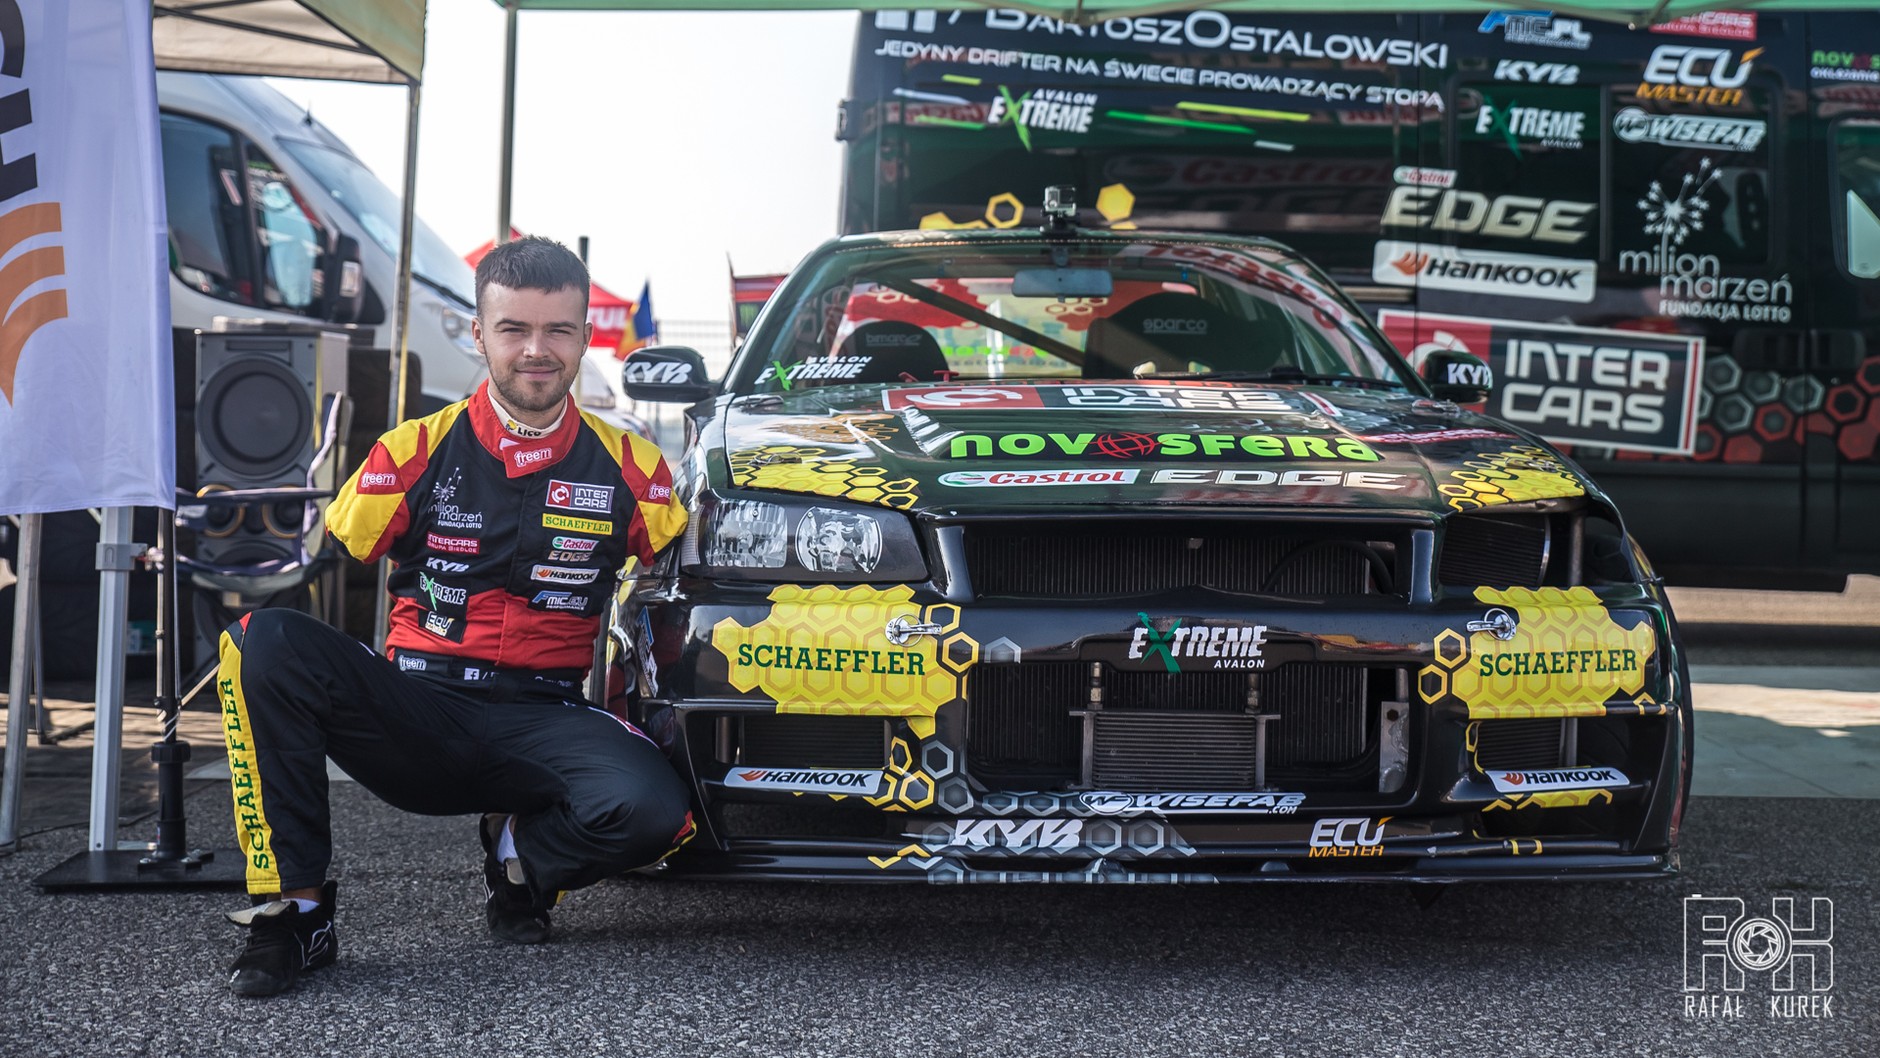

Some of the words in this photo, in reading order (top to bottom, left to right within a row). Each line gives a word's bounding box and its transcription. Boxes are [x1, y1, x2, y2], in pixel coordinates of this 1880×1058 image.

[874, 39, 964, 63] JEDYNY
[967, 46, 1061, 73] DRIFTER
[1065, 57, 1099, 77] NA
[1104, 57, 1195, 85] ŚWIECIE
[1199, 69, 1362, 101] PROWADZĄCY
[1494, 59, 1580, 85] KYB
[1643, 44, 1766, 88] ECU
[1033, 89, 1098, 106] AVALON
[1635, 81, 1743, 106] MASTER
[987, 85, 1095, 151] EXTREME
[1475, 95, 1586, 160] EXTREME
[1649, 116, 1766, 148] WISEFAB
[1380, 185, 1599, 244] EDGE
[1619, 245, 1720, 277] milion
[1660, 273, 1792, 304] marzeń
[1659, 301, 1740, 323] FUNDACJA
[1743, 304, 1792, 323] LOTTO
[806, 356, 873, 365] AVALON
[1505, 339, 1669, 391] INTER
[624, 361, 692, 384] KYB
[754, 360, 866, 391] EXTREME
[1501, 384, 1664, 434] CARS
[518, 427, 542, 437] LICO
[514, 447, 552, 467] freem
[361, 472, 397, 488] freem
[649, 483, 672, 499] free
[988, 470, 1127, 485] Castrol
[1150, 469, 1406, 491] EDGE
[574, 497, 607, 509] CARS
[575, 487, 608, 499] INTER
[437, 520, 465, 529] FUNDACJA
[438, 511, 483, 523] marzeń
[545, 516, 611, 533] SCHAEFFLER
[548, 550, 593, 562] EDGE
[563, 539, 595, 550] Castrol
[426, 556, 470, 573] KYB
[419, 571, 467, 611] EXTREME
[426, 610, 455, 630] ECU
[1129, 612, 1268, 674] EXTREME
[738, 643, 925, 676] SCHAEFFLER
[1213, 659, 1265, 669] AVALON
[1479, 649, 1638, 677] SCHAEFFLER
[220, 678, 270, 870] SCHAEFFLER
[1133, 792, 1307, 807] WISEFAB
[952, 820, 1083, 848] KYB
[1309, 817, 1393, 848] ECU
[1309, 846, 1384, 858] MASTER
